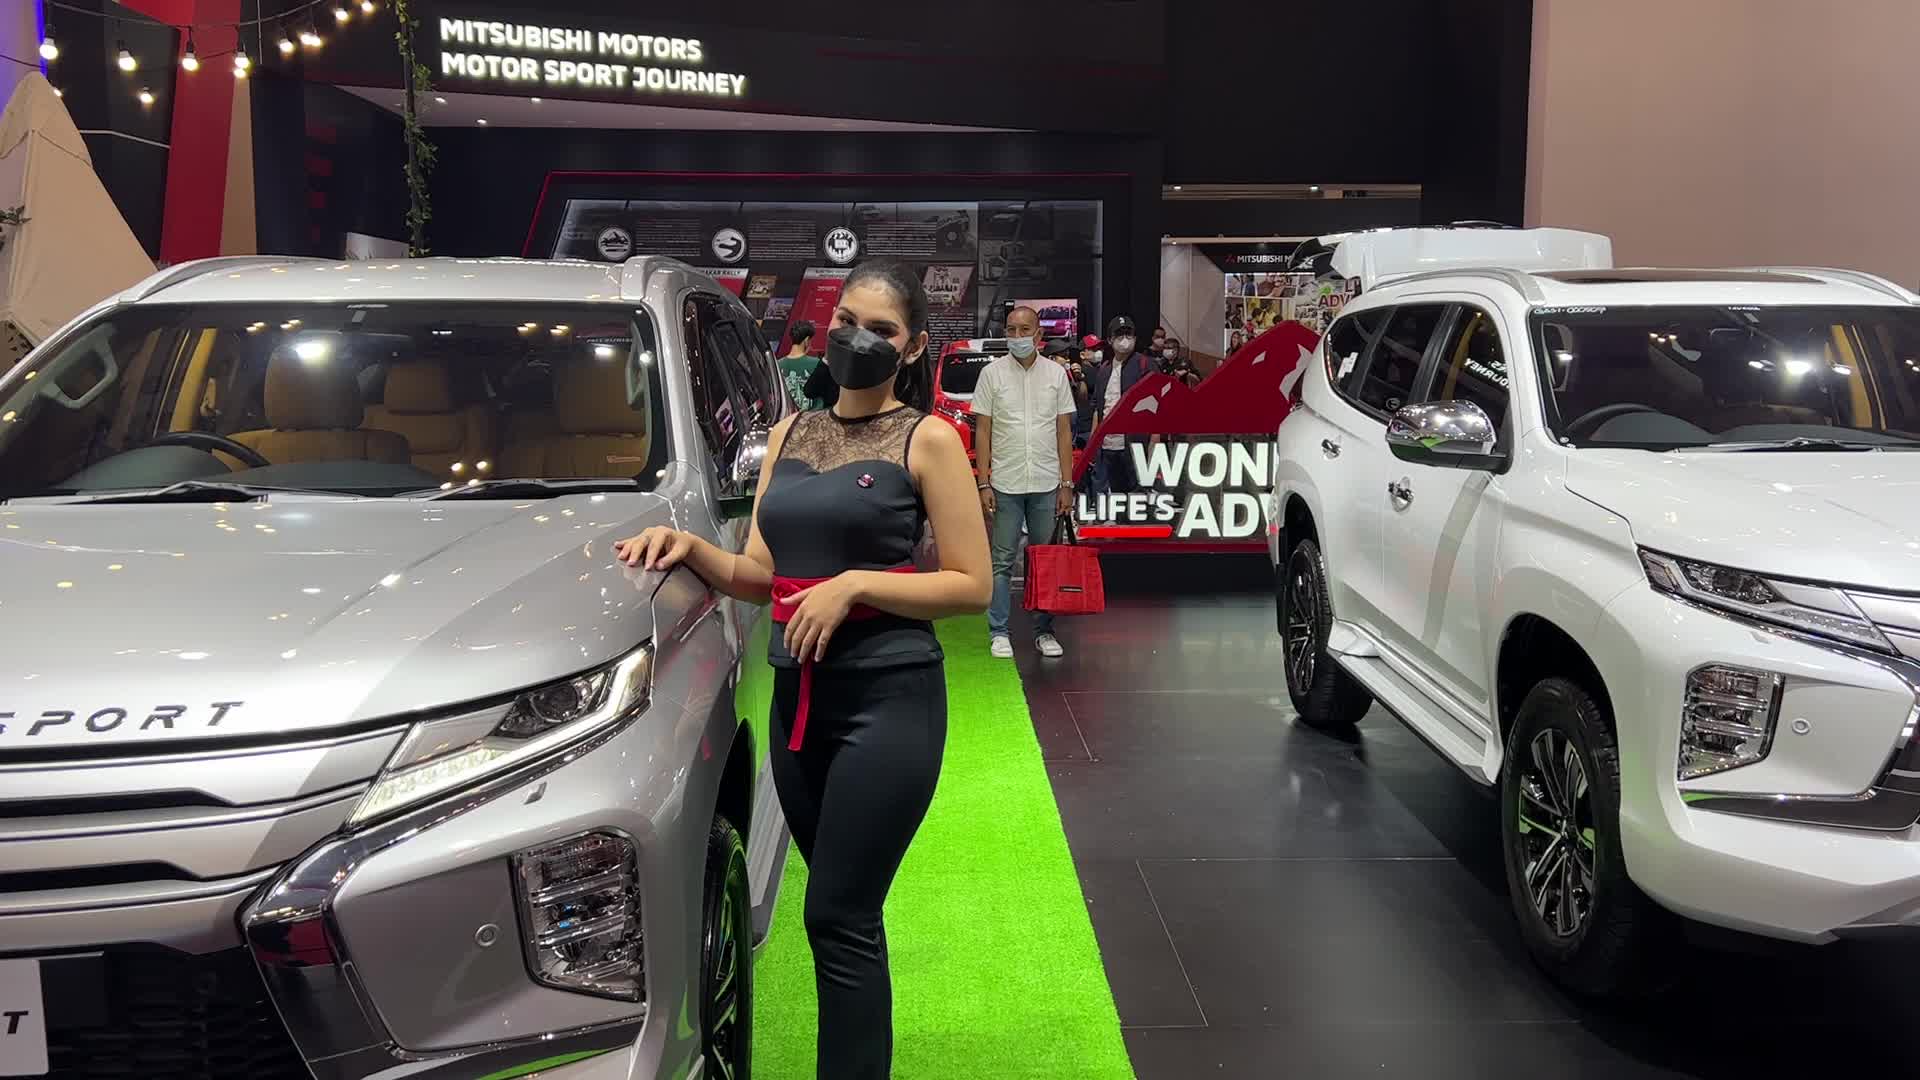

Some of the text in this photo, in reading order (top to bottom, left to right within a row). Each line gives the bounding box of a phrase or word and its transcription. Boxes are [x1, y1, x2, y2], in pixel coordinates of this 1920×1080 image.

[440, 18, 702, 60] MITSUBISHI MOTORS
[441, 53, 745, 95] MOTOR SPORT JOURNEY
[1236, 255, 1284, 264] MITSUBISHI
[1131, 442, 1279, 487] WON
[1078, 492, 1175, 521] LIFE'S
